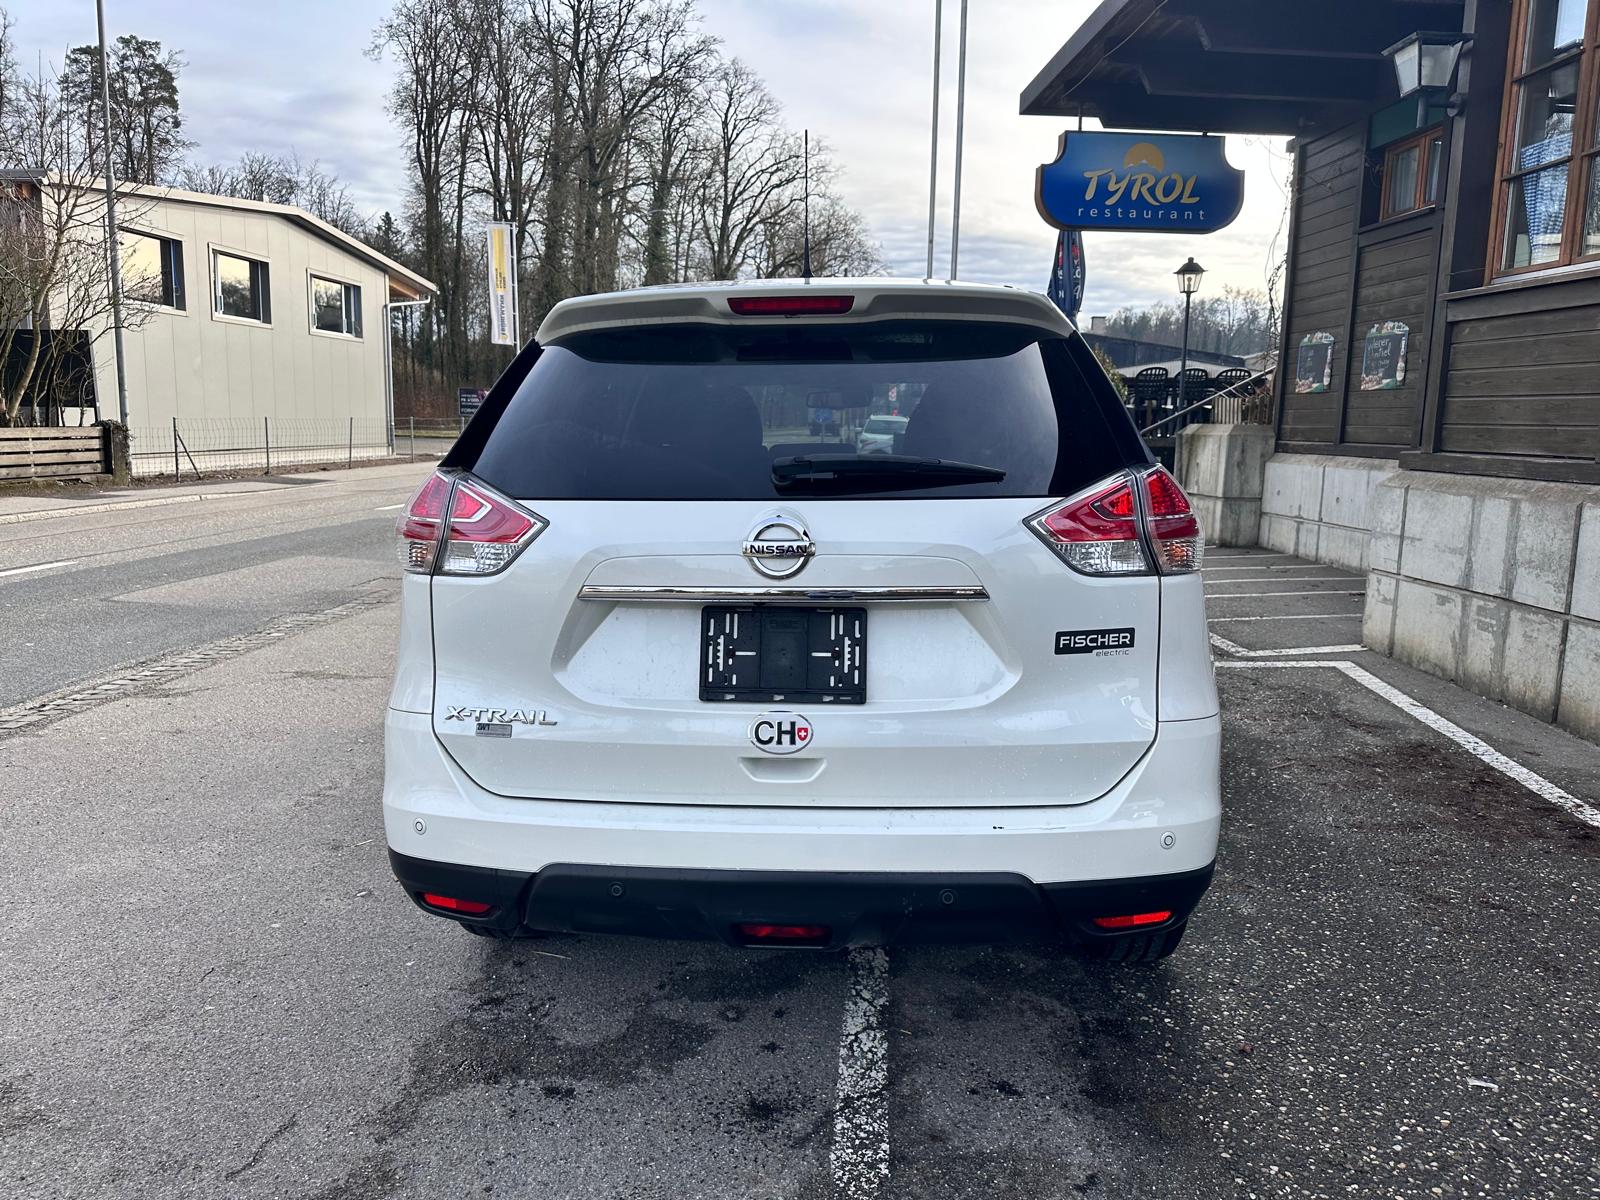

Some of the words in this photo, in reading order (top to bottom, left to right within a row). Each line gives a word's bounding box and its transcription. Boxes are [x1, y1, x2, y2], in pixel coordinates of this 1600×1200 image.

[1083, 169, 1201, 206] TYROL
[1078, 207, 1205, 220] restaurant
[750, 544, 807, 554] NISSAN
[1060, 633, 1131, 648] FISCHER
[1095, 649, 1130, 657] electric
[444, 706, 558, 726] X-TRAIL
[754, 720, 797, 745] CH
